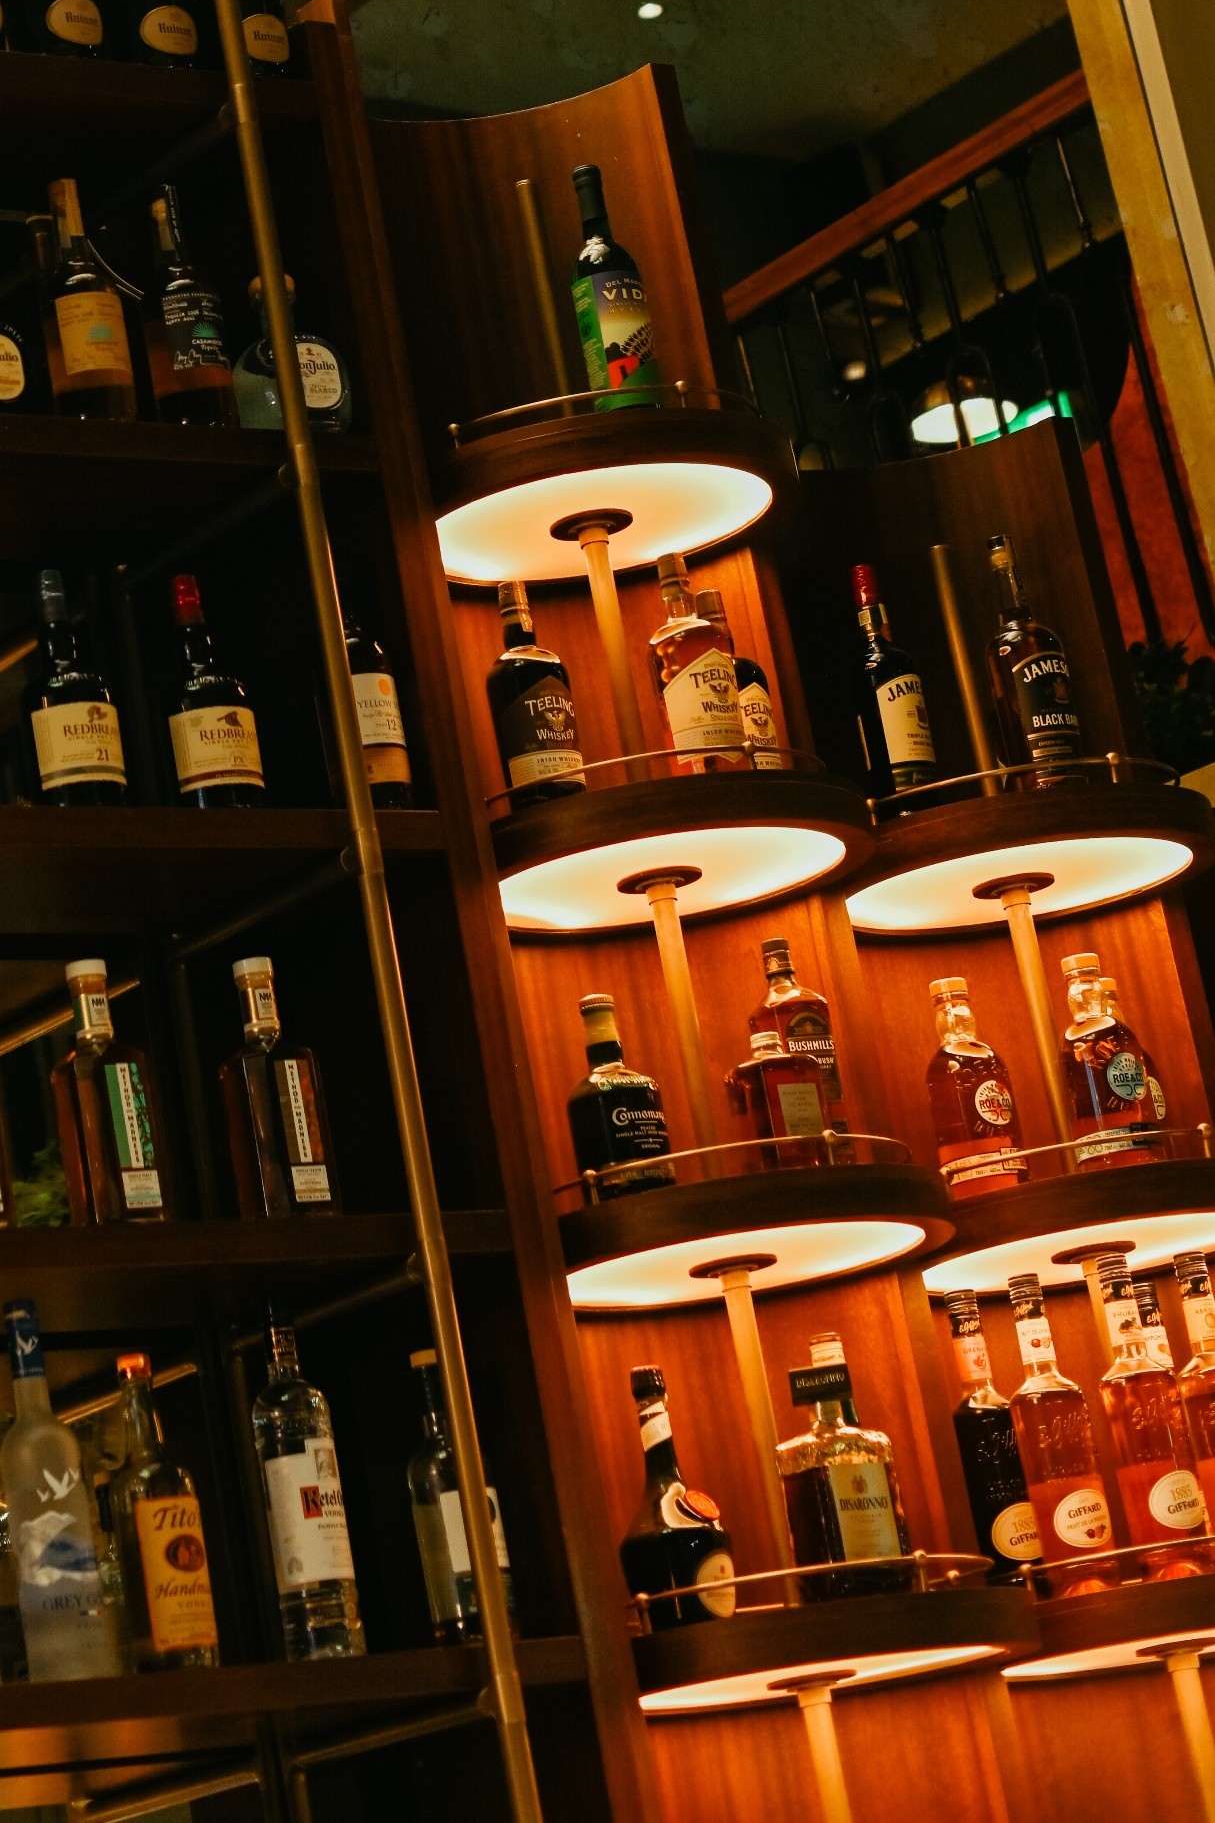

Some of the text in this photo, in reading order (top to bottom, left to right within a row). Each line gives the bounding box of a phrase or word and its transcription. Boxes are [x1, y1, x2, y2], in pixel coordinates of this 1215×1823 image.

[602, 287, 648, 302] VID
[1023, 659, 1070, 683] JAMES
[887, 680, 922, 702] JAME
[524, 695, 575, 717] TEELING
[1032, 713, 1064, 727] BLACK
[536, 728, 575, 741] WHISKEY
[95, 748, 110, 762] 21
[788, 1040, 835, 1053] BUSHMILLS
[840, 1496, 888, 1512] DISARONNO
[1068, 1502, 1102, 1519] GIFFARD
[1168, 1499, 1200, 1515] GIFFARD
[1009, 1531, 1038, 1547] GIFFAR
